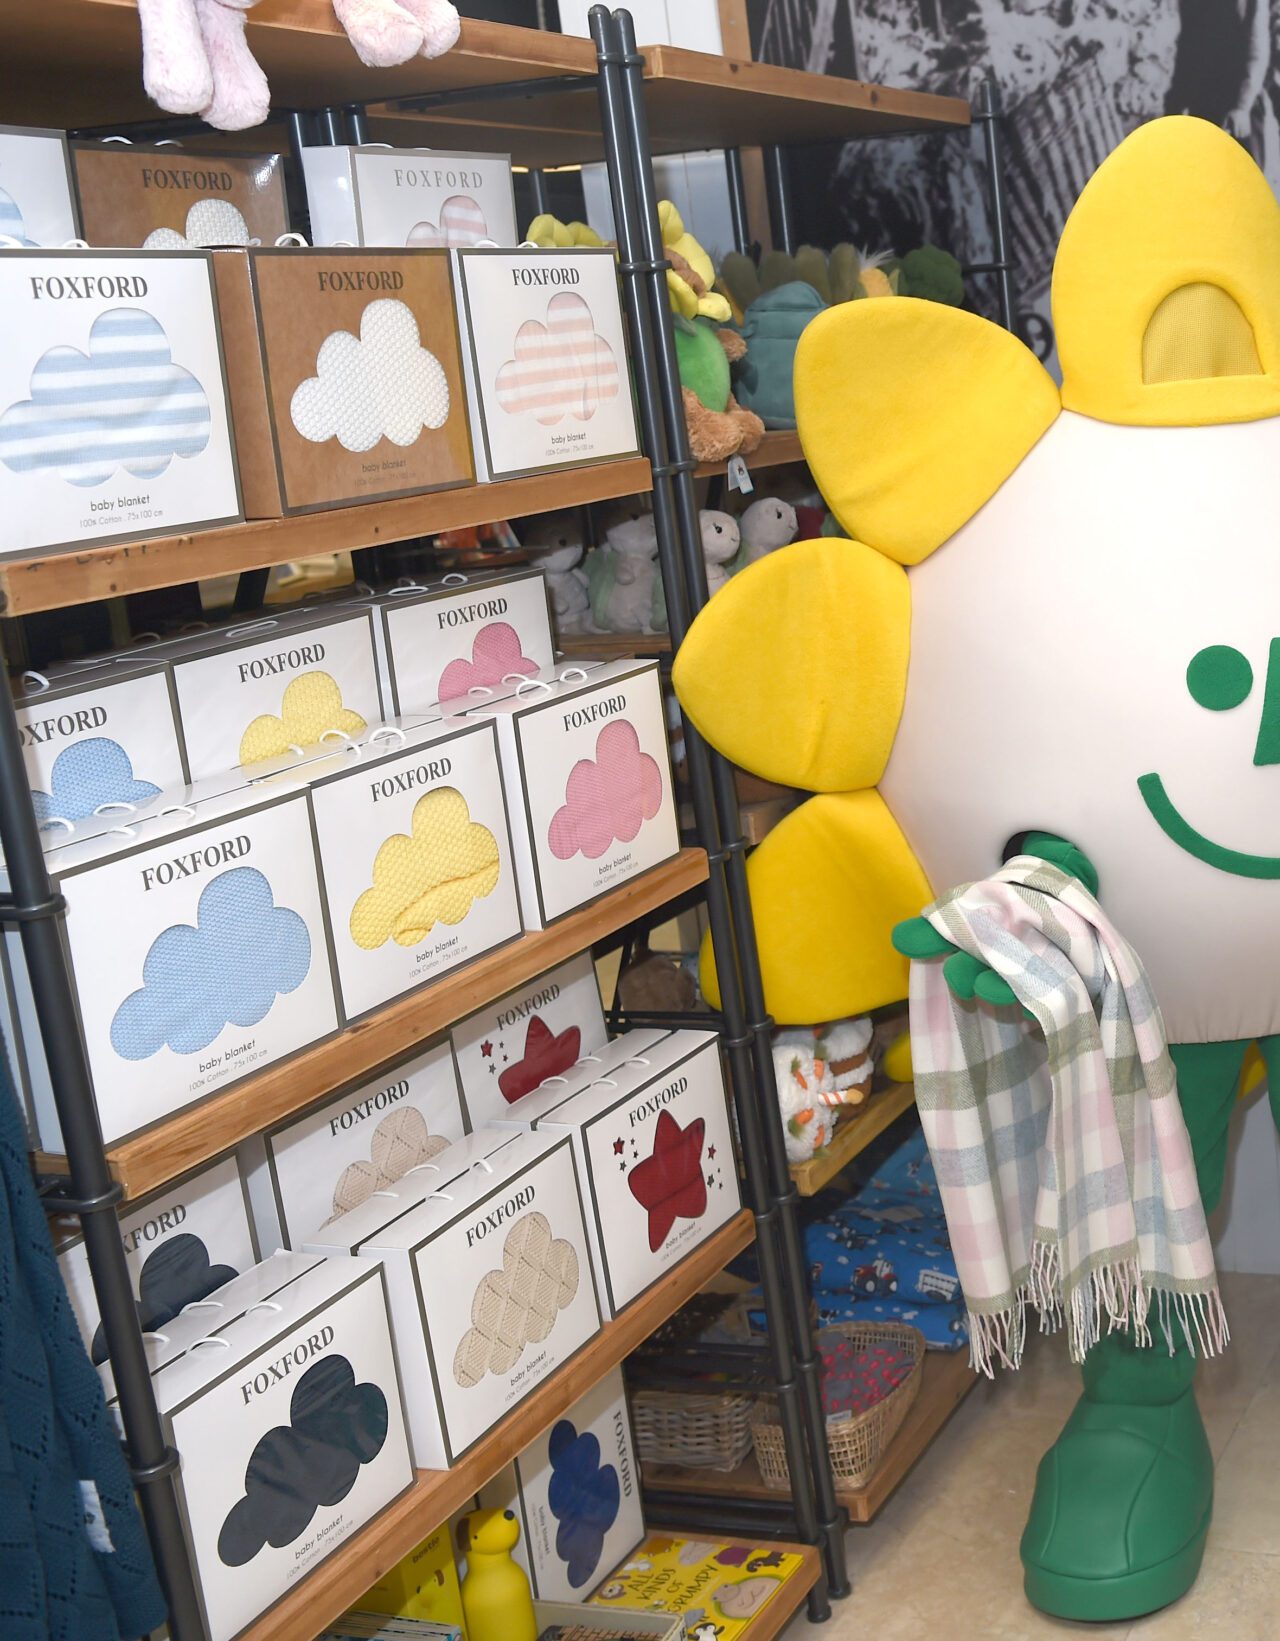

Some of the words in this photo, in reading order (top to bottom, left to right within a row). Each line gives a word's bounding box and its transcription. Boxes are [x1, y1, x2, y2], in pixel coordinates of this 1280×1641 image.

[142, 168, 233, 192] FOXFORD
[394, 169, 483, 188] FOXFORD
[30, 276, 148, 300] FOXFORD
[318, 271, 404, 292] FOXFORD
[512, 268, 580, 286] FOXFORD
[551, 435, 565, 445] baby
[567, 432, 586, 442] blanket
[362, 463, 380, 472] baby
[382, 459, 406, 470] blanket
[90, 499, 115, 512] baby
[117, 494, 150, 507] blanket
[437, 598, 508, 629] FOXFORD
[238, 643, 325, 683] FOXFORD
[562, 694, 627, 732] FOXFORD
[370, 757, 452, 802] FOXFORD
[141, 835, 251, 892] FOXFORD
[598, 863, 612, 875] baby
[613, 852, 632, 867] blanket
[416, 950, 434, 962] baby
[435, 936, 459, 953] blanket
[496, 983, 561, 1031] FOXFORD
[199, 1057, 222, 1073] baby
[224, 1039, 255, 1060] blanket
[329, 1080, 409, 1137] FOXFORD
[628, 1077, 688, 1128] FOXFORD
[465, 1185, 535, 1248] FOXFORD
[240, 1325, 334, 1405] FOXFORD
[511, 1371, 525, 1386] baby
[527, 1350, 546, 1372] blanket
[613, 1409, 633, 1498] FOXFORD
[295, 1539, 315, 1560] baby
[316, 1514, 343, 1542] blanket
[627, 1573, 654, 1591] ALL
[636, 1567, 676, 1600] KINDS
[667, 1564, 718, 1613] GRUMPY
